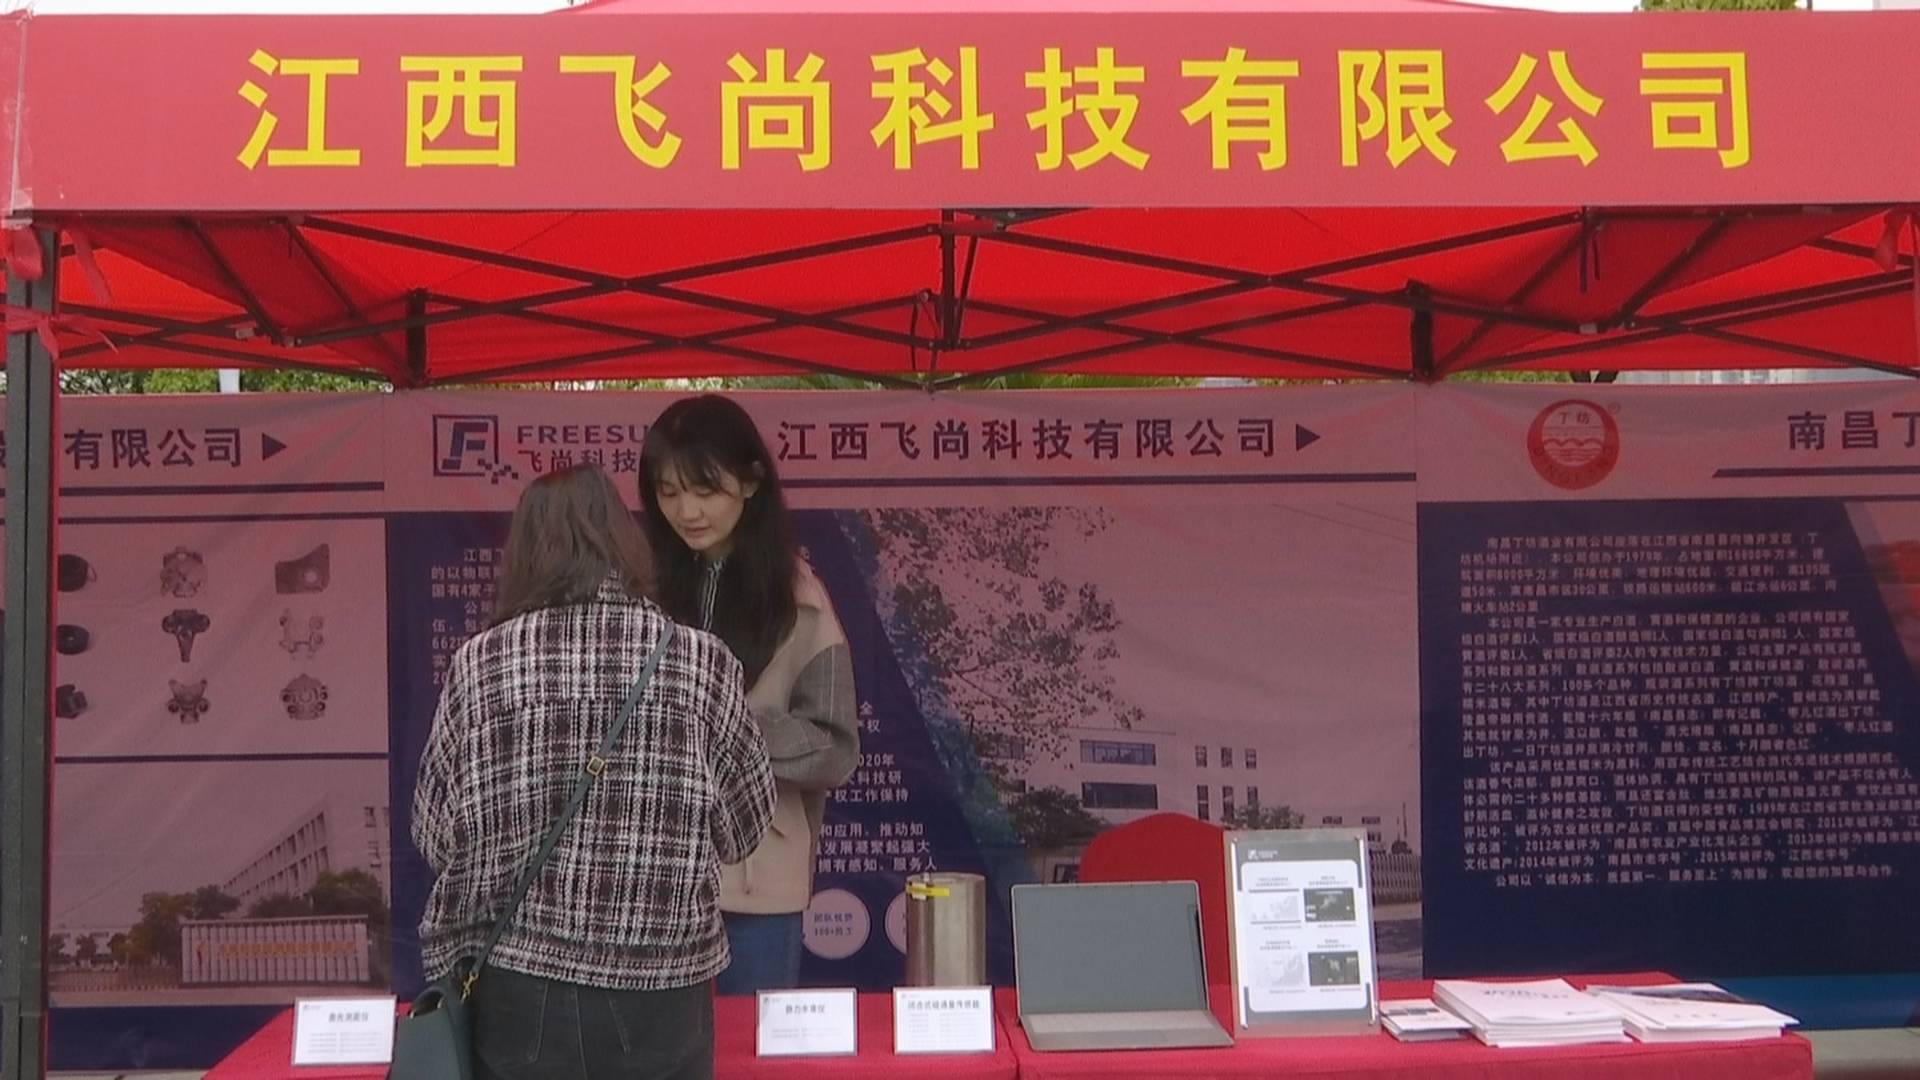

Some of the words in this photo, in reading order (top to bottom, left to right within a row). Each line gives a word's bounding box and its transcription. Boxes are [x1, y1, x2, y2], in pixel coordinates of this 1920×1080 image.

[237, 47, 1752, 172] 江西飞尚科技有限公司
[779, 419, 1275, 461] 江西飞尚科技有限公司
[1788, 411, 1920, 450] 南昌丁
[849, 771, 902, 785] 科技研
[826, 788, 909, 802] 权工作保持
[817, 839, 930, 855] 发展凝聚起强大
